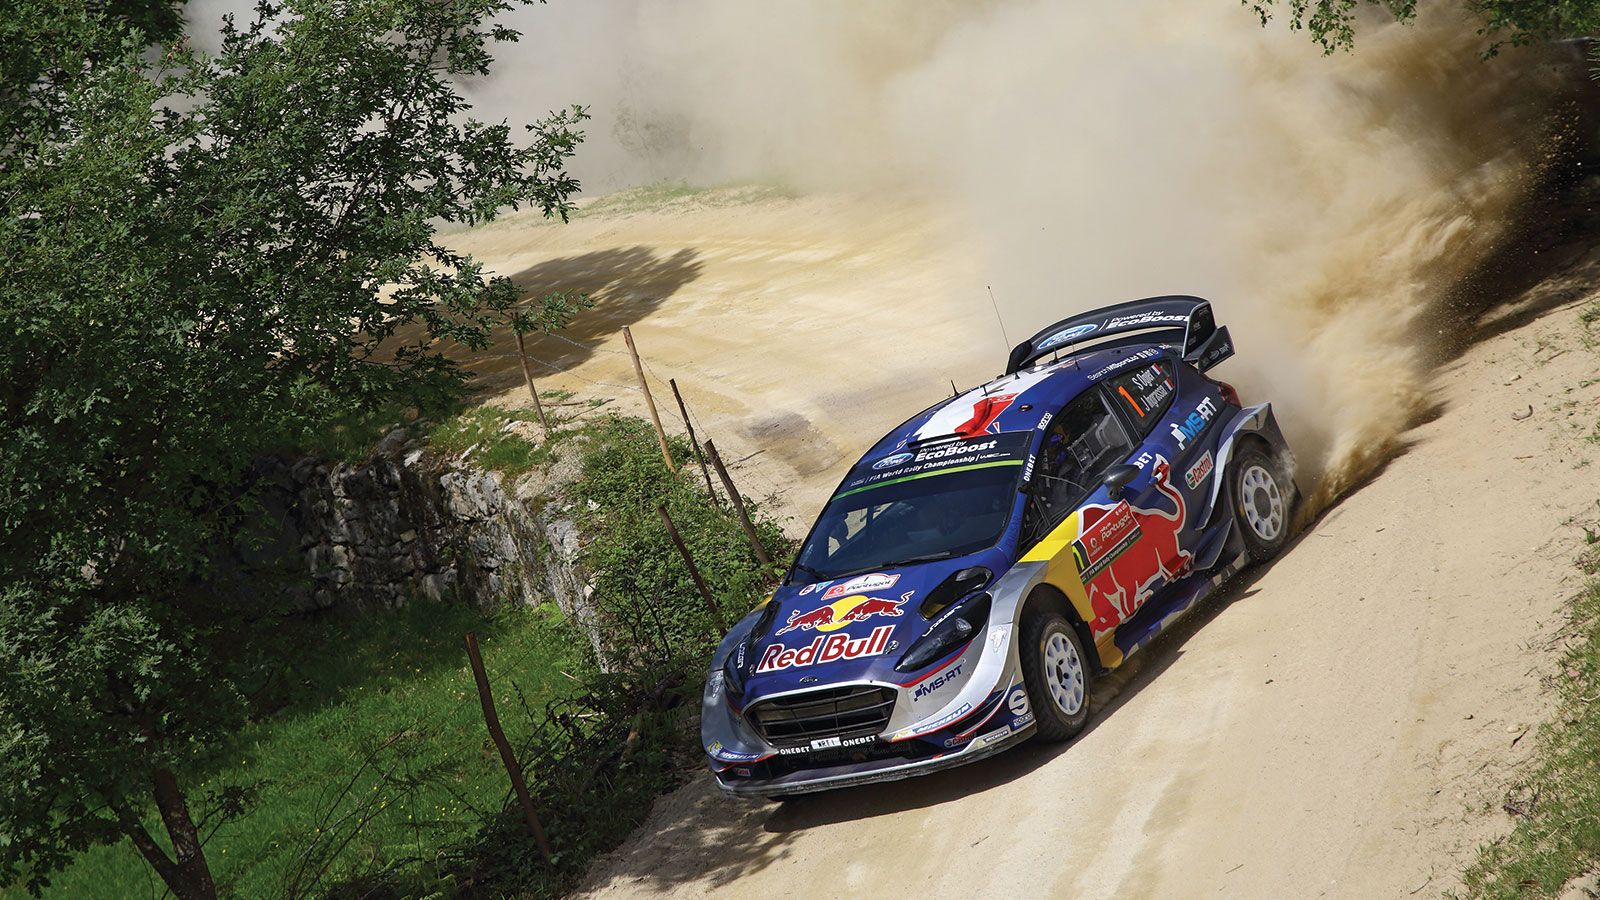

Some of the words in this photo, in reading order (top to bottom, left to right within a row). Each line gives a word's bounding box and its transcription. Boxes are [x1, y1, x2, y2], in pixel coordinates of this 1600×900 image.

[1111, 312, 1151, 323] Powered
[1132, 377, 1144, 390] S
[1118, 385, 1145, 417] 1
[1140, 396, 1151, 412] J
[914, 440, 998, 462] EcoBoost
[919, 442, 956, 453] Powered
[869, 474, 880, 482] FIA
[882, 468, 904, 479] World
[904, 465, 923, 474] Rally
[923, 455, 976, 469] Championship
[1023, 454, 1036, 482] ONEBET
[1192, 454, 1213, 482] Castrol
[757, 635, 826, 672] Red
[819, 626, 894, 663] Bull
[916, 703, 970, 733] MICHELIN
[780, 746, 810, 755] ONEBET
[843, 735, 876, 747] ONEBET
